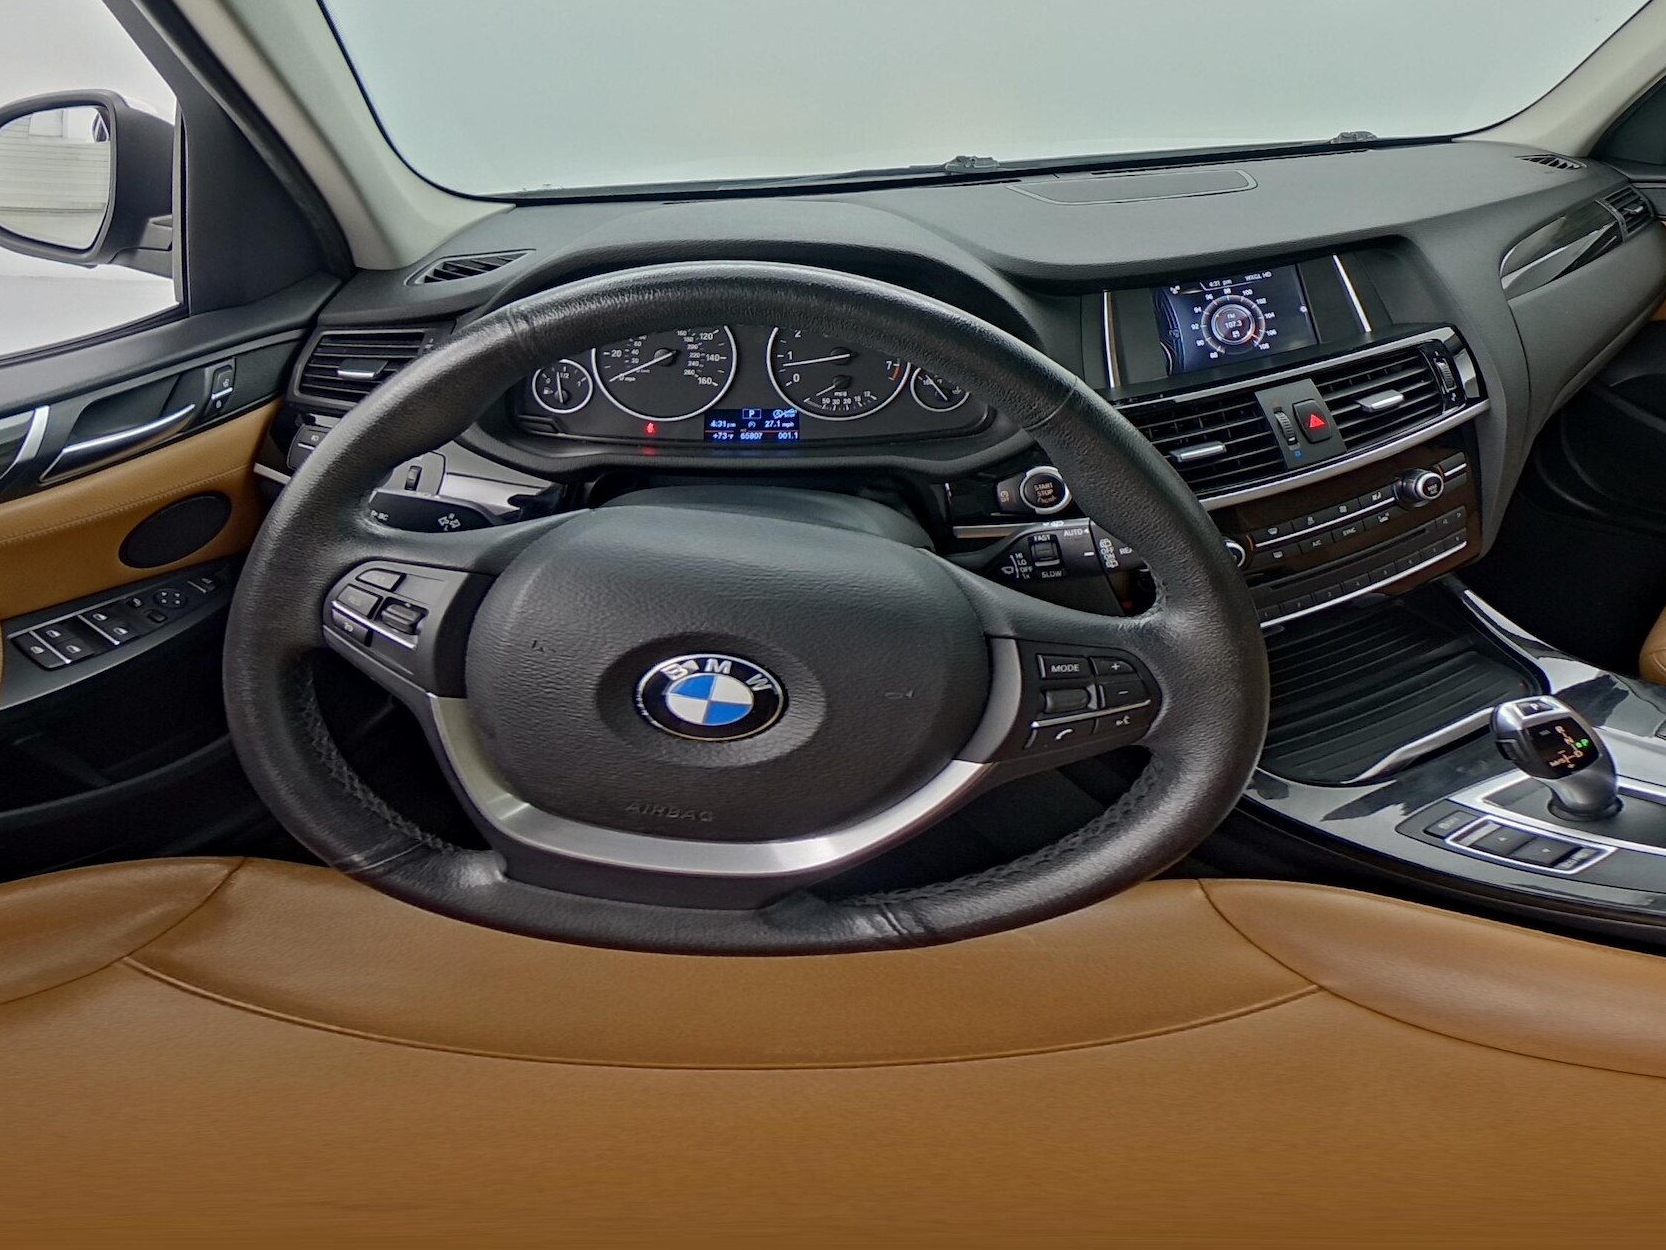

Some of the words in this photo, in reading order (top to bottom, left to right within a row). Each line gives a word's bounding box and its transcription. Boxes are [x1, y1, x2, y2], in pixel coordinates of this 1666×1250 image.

[787, 351, 793, 360] 1
[886, 361, 892, 370] 7
[698, 377, 712, 385] 160
[793, 374, 800, 382] 0
[1051, 664, 1079, 673] MODE
